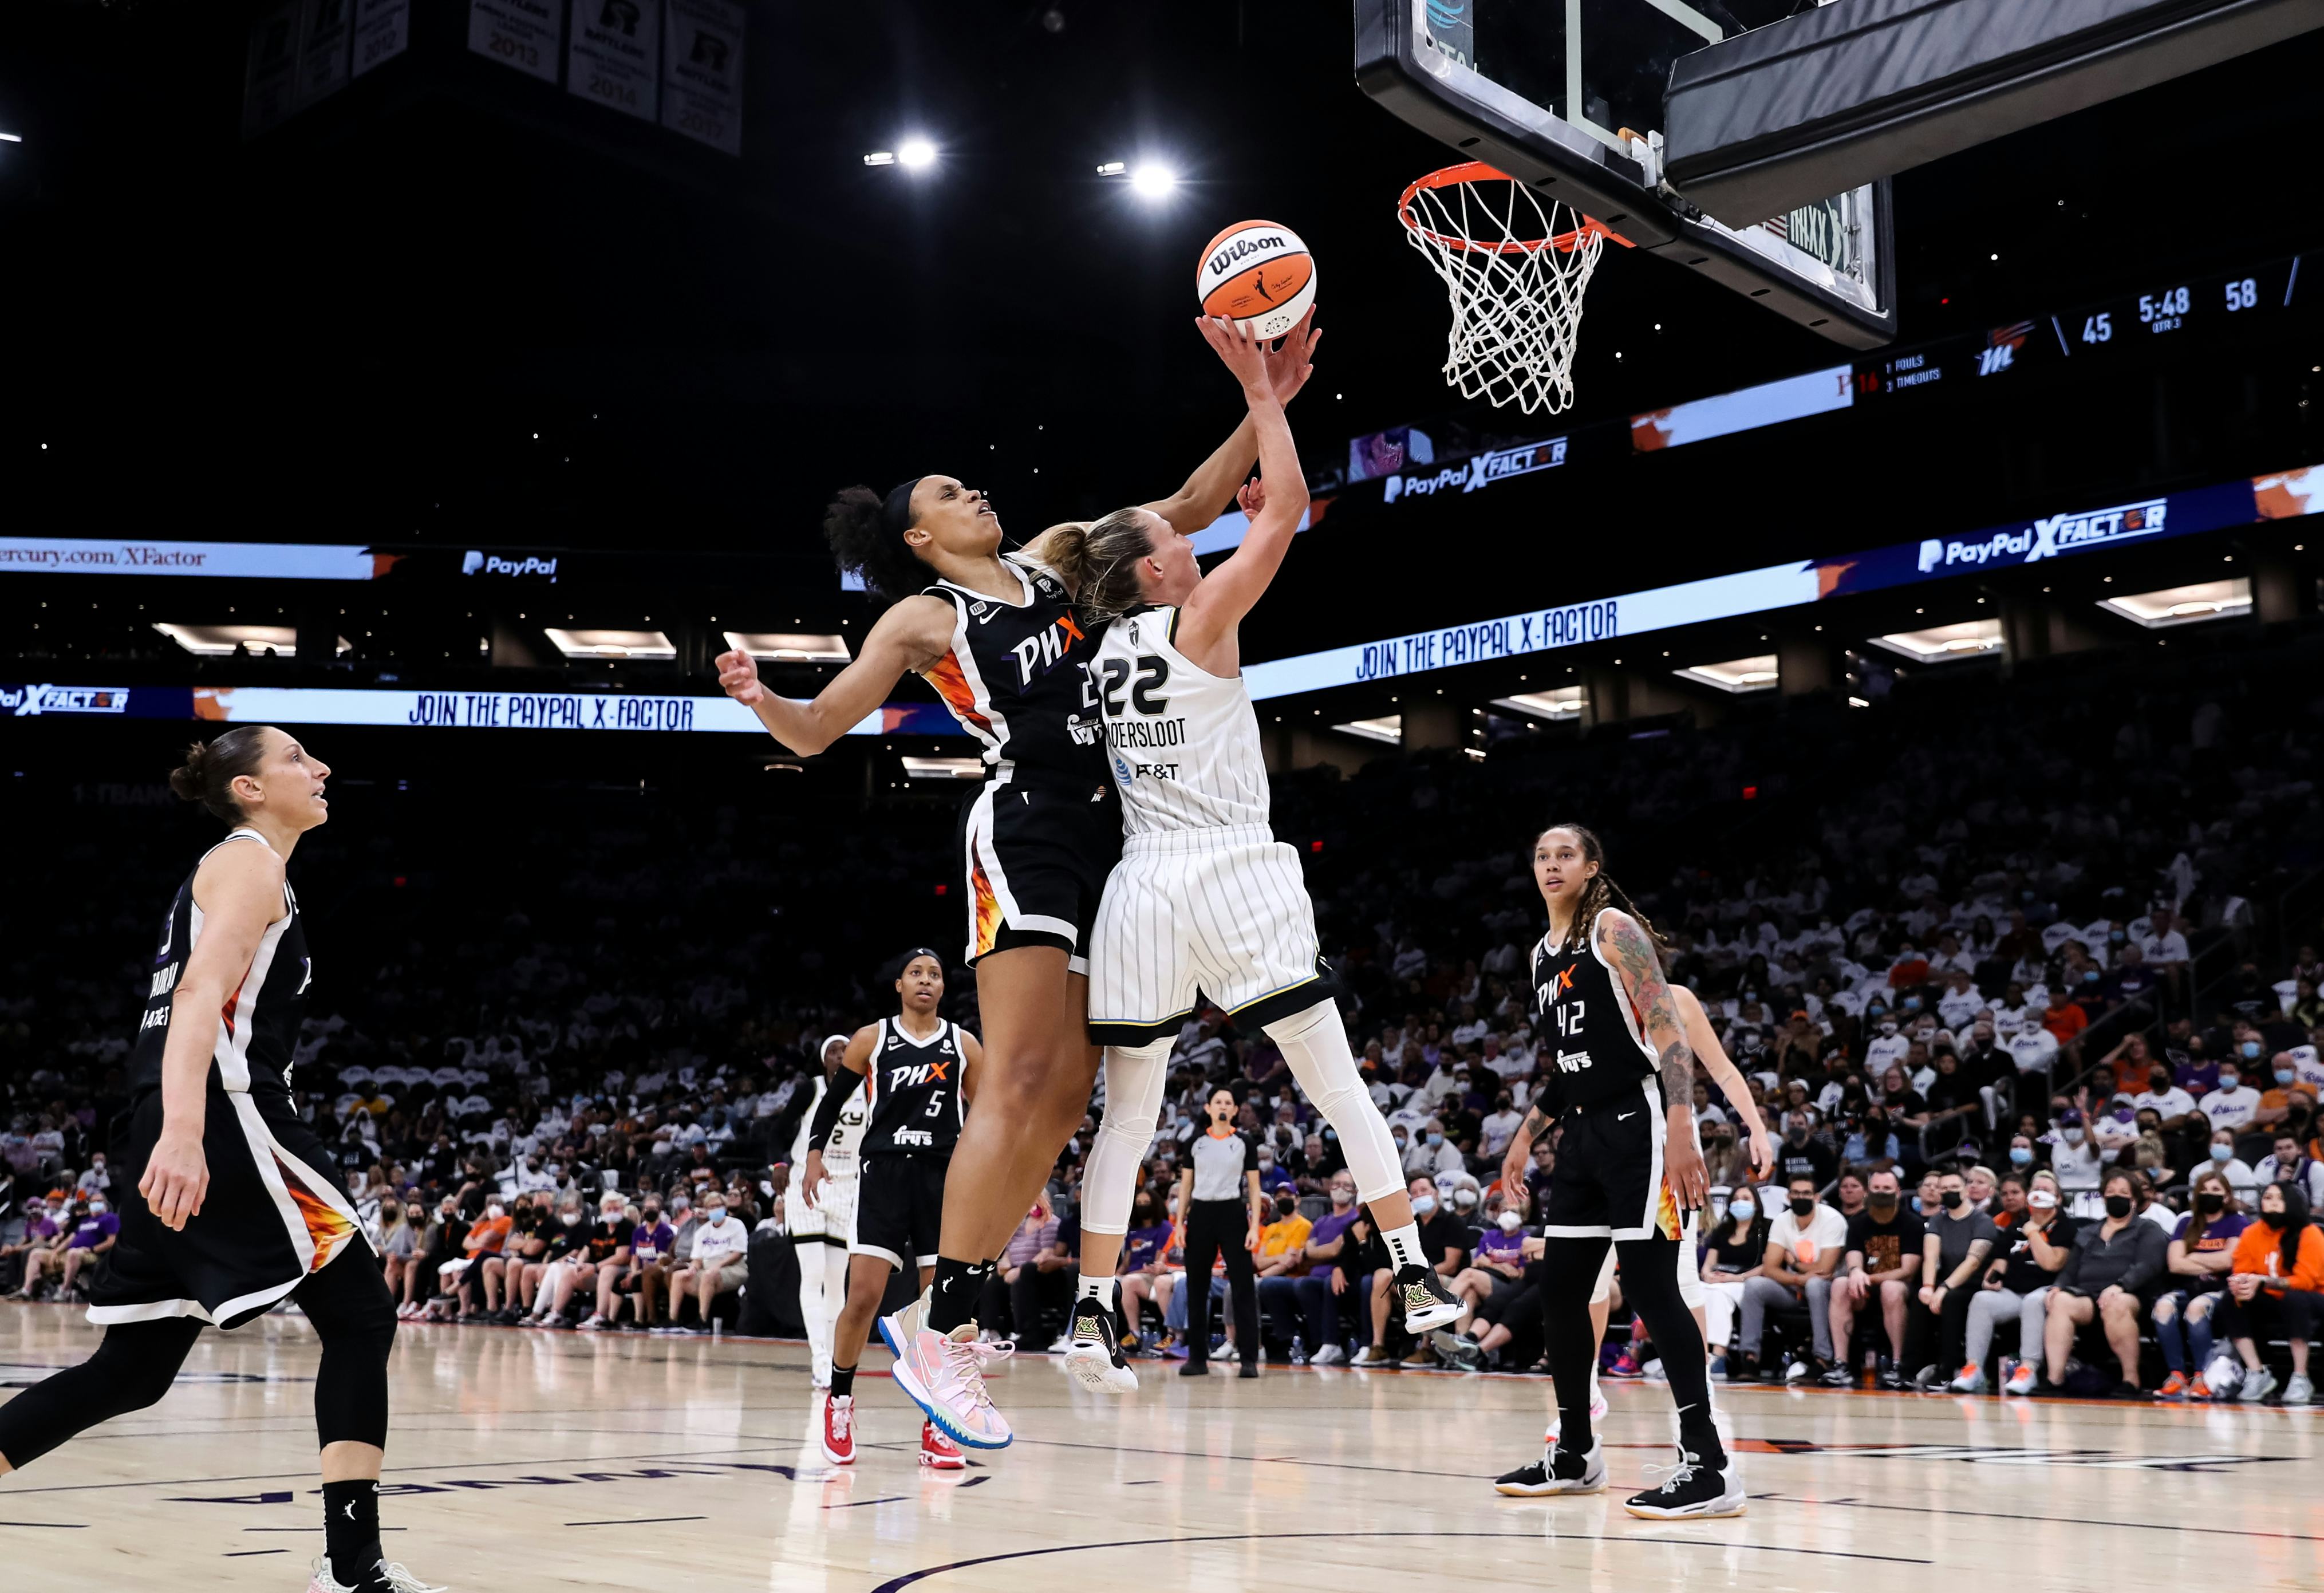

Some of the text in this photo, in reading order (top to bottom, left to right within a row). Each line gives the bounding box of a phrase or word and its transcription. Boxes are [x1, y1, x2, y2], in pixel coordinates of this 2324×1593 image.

[489, 30, 538, 68] 2013
[588, 72, 636, 108] 2014
[1209, 236, 1287, 275] Wilson
[2138, 286, 2191, 322] 5:48
[2224, 277, 2257, 311] 58
[2082, 312, 2112, 344] 45
[1896, 353, 1924, 372] FOULS
[1897, 367, 1942, 389] TIMEOUTS
[1404, 464, 1469, 496] PayPal
[1946, 528, 2032, 565] PayPal
[486, 555, 557, 577] PayPal
[1011, 609, 1085, 686] PHX
[1356, 641, 1397, 680] JOIN
[1404, 634, 1435, 673] THE
[1442, 620, 1513, 667] PAYPAL
[1102, 654, 1171, 717] 22
[409, 694, 457, 725] JOIN
[466, 695, 500, 727] THE
[508, 696, 585, 729] PAYPAL
[1136, 764, 1178, 780] AT&T
[1537, 963, 1577, 1015] PHX
[1557, 1000, 1585, 1037] 42
[890, 1061, 950, 1093] PHX
[838, 1111, 863, 1126] KY
[925, 1090, 946, 1117] 5
